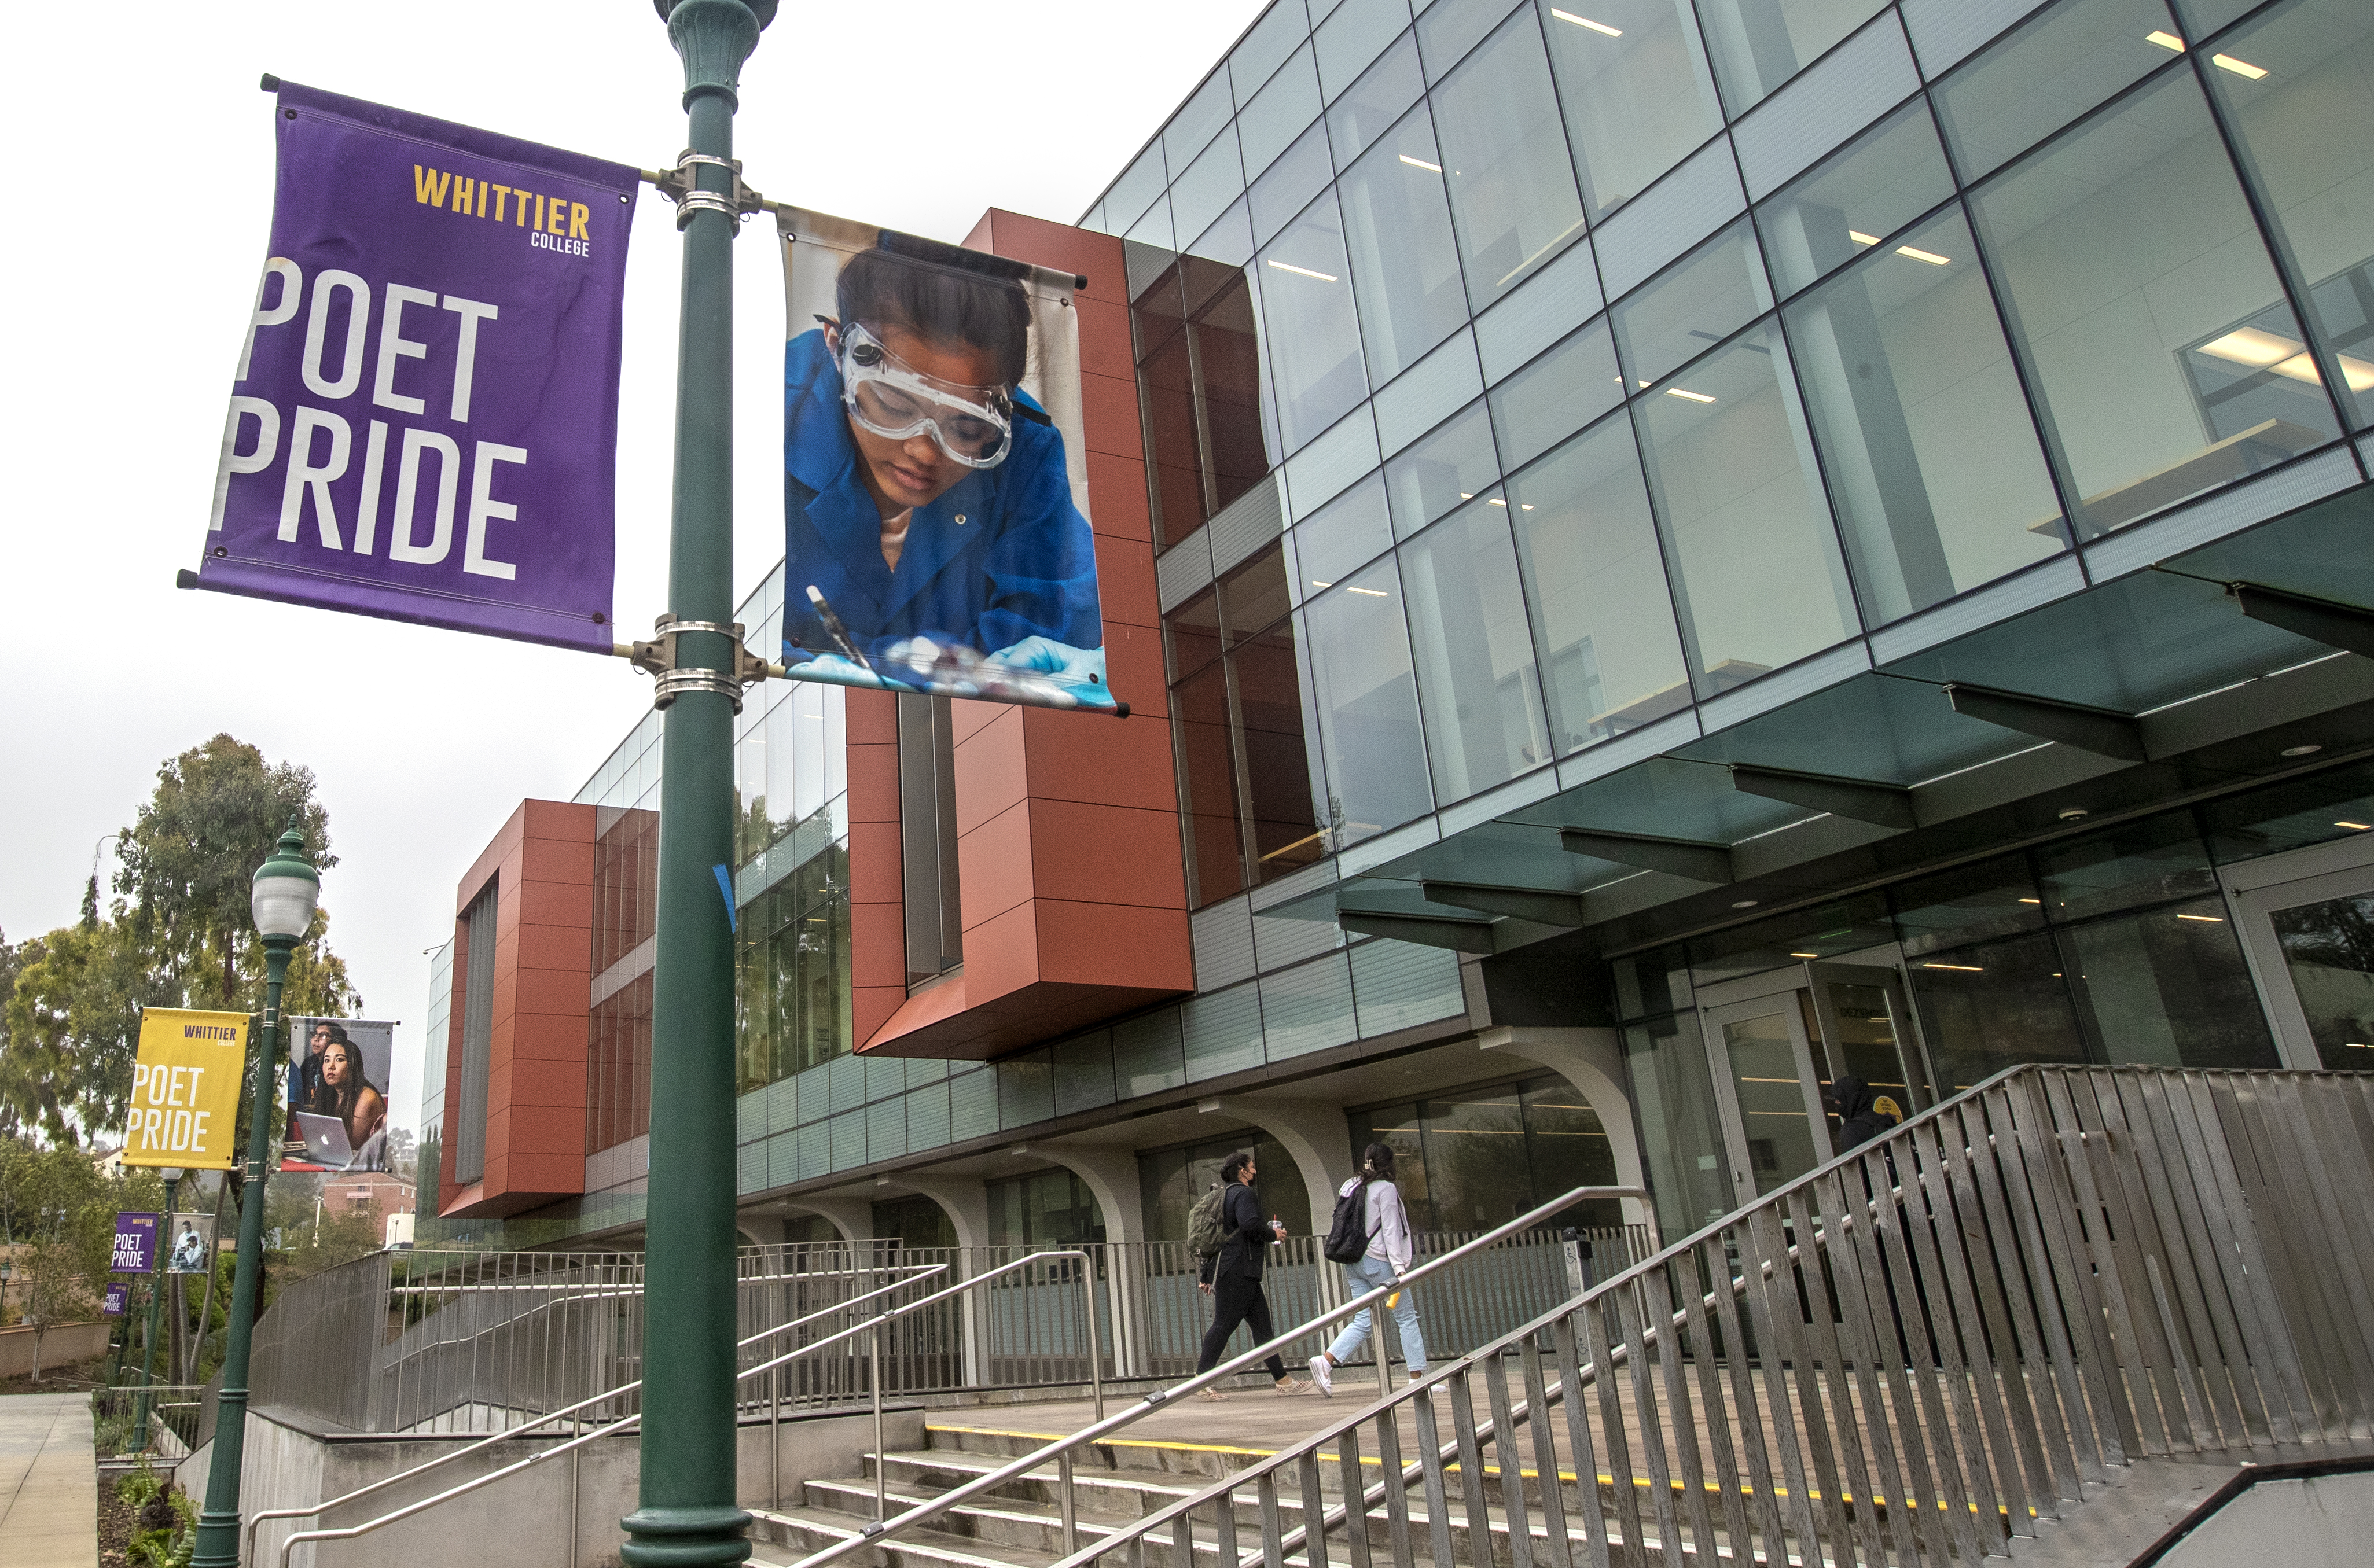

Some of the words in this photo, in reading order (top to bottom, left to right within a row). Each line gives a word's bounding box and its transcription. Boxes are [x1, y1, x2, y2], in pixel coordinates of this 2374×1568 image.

[414, 164, 590, 241] WHITTIER
[531, 232, 589, 257] COLLEGE
[235, 256, 498, 424] POET
[209, 395, 527, 581] PRIDE
[185, 1025, 236, 1040] WHITTIER
[130, 1063, 204, 1107] POET
[122, 1107, 210, 1152] PRIDE
[111, 1250, 144, 1267] PRIDE
[114, 1234, 142, 1250] POET
[103, 1302, 120, 1311] PRIDE
